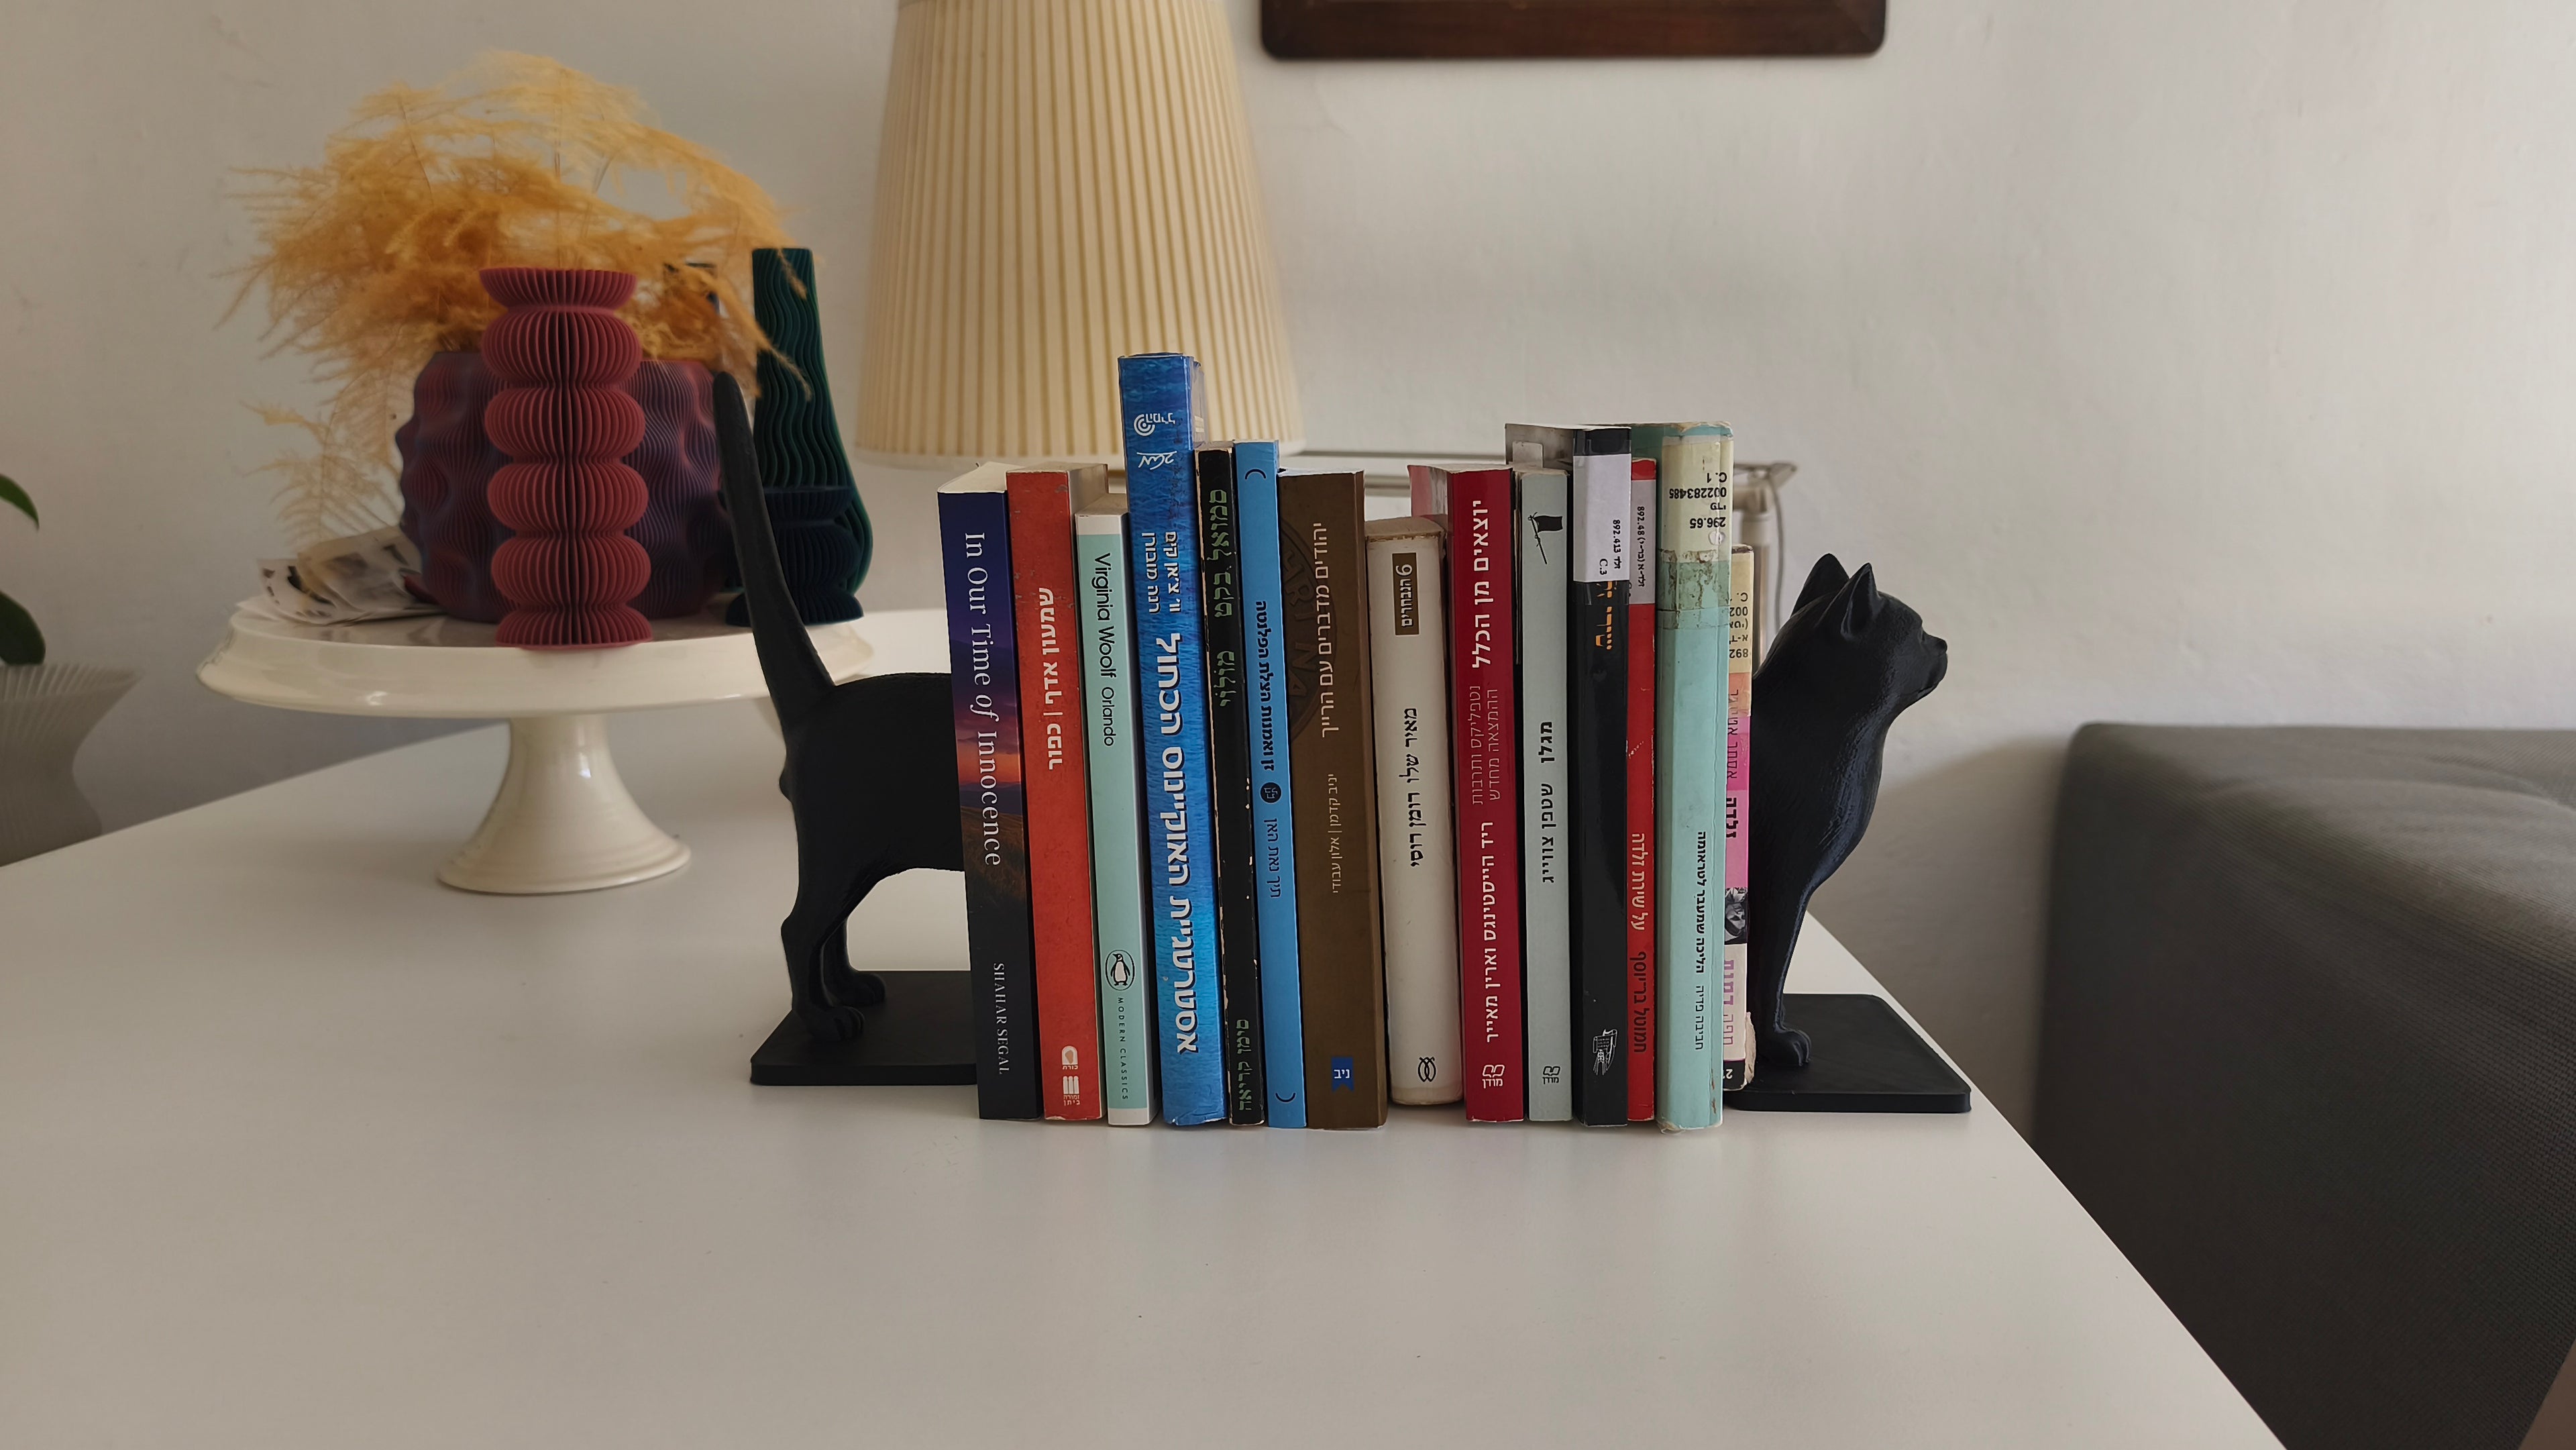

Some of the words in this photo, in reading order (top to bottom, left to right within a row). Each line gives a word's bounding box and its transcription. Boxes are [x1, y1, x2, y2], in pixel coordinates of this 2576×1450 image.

[1707, 472, 1712, 483] 1
[1715, 472, 1727, 482] C.
[1207, 490, 1232, 561] סמואל
[1472, 500, 1489, 571] יוצאים
[1613, 519, 1621, 553] 892.413
[1638, 506, 1646, 535] 892.48
[1689, 517, 1726, 529] 296.65
[965, 532, 985, 557] In
[1142, 532, 1157, 580] מובורן
[1163, 531, 1179, 558] קים
[1313, 522, 1329, 578] יהודים
[1614, 556, 1622, 569] זלד
[1091, 553, 1111, 621] Virginia
[1599, 558, 1608, 576] C.3
[967, 566, 988, 614] Our
[1148, 586, 1159, 613] רנה
[1213, 570, 1234, 617] בקט
[1400, 578, 1413, 627] הנבחרים
[1474, 581, 1494, 605] מן
[1039, 588, 1060, 656] שמעון
[1255, 601, 1273, 659] הפלנטה
[1316, 585, 1332, 655] מדברים
[1729, 607, 1748, 616] 002
[971, 623, 994, 685] Time
[1097, 627, 1116, 678] Woolf
[1472, 613, 1491, 668] הכלל
[1729, 648, 1748, 658] 892
[1044, 662, 1063, 705] אדף
[1156, 633, 1181, 735] הכחול
[1258, 662, 1275, 703] הצלת
[1319, 661, 1334, 686] עם
[970, 694, 1000, 723] of
[1102, 686, 1116, 747] Orlando
[1320, 692, 1340, 738] הרייך
[1403, 708, 1417, 747] מאיר
[1467, 686, 1485, 748] נטפליקס
[1487, 689, 1500, 752] ההמצאה
[1045, 723, 1063, 770] כפור
[1261, 706, 1274, 756] ואמנות
[1538, 721, 1555, 764] מגלן
[1260, 760, 1275, 771] זן
[1328, 774, 1338, 794] יניב
[1399, 754, 1419, 783] שלו
[1470, 754, 1483, 805] ותרבות
[1488, 758, 1501, 800] מחדש
[977, 730, 1001, 866] Innocence
[1160, 746, 1189, 884] האוקיינוס
[1328, 798, 1342, 826] קדמן
[1407, 792, 1427, 827] רומן
[1540, 783, 1556, 829] שטפן
[1726, 797, 1739, 838] זלדה
[1263, 818, 1279, 843] האן
[1329, 837, 1343, 860] אלון
[1409, 833, 1424, 867] רוסי
[1481, 822, 1494, 848] ריד
[1631, 833, 1648, 867] זלדה
[1268, 847, 1280, 872] נאת
[1331, 863, 1342, 893] עבודי
[1541, 836, 1555, 884] צווייג
[1696, 831, 1707, 886] לטראומה
[1267, 876, 1282, 898] תיך
[1481, 856, 1497, 941] הייסטינגס
[1631, 871, 1646, 908] שירת
[1631, 912, 1648, 931] על
[1695, 889, 1707, 934] שמעבר
[1170, 896, 1198, 1053] אסטרטגיית
[1483, 948, 1501, 989] וארין
[1695, 938, 1706, 974] הליכה
[994, 962, 1008, 1025] SHAHAR
[1695, 985, 1706, 1012] פדיה
[1118, 997, 1126, 1042] MODERN
[1236, 1019, 1251, 1054] סימן
[1485, 996, 1499, 1043] מאייר
[1634, 1008, 1650, 1053] חמוטל
[1695, 1016, 1706, 1050] חביבה
[998, 1028, 1010, 1075] SEGAL
[1120, 1048, 1128, 1100] CLASSICS
[1238, 1061, 1252, 1110] קריאה
[1334, 1068, 1350, 1079] ניב
[1482, 1078, 1503, 1089] מודן
[1542, 1077, 1560, 1085] מודן
